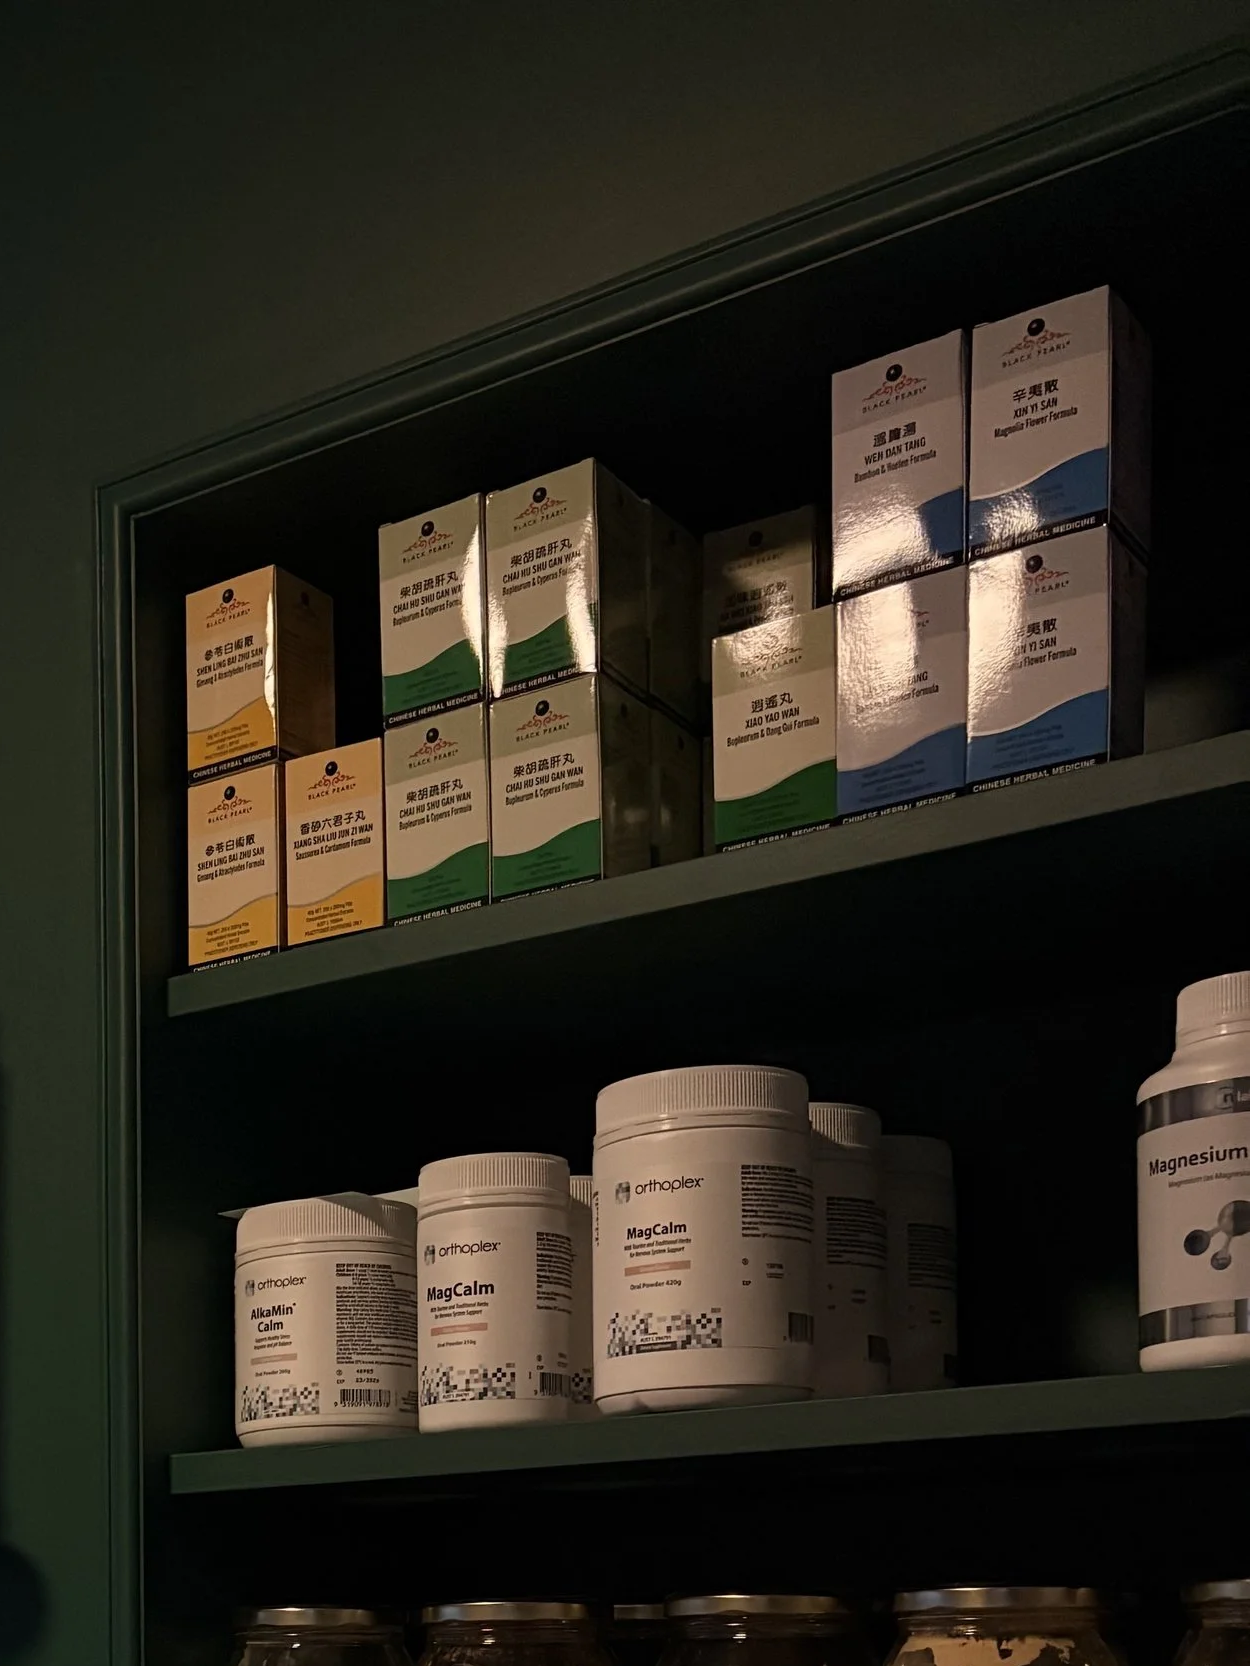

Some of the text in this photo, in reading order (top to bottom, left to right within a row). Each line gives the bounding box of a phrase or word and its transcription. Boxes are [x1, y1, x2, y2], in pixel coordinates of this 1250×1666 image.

[1013, 397, 1058, 418] XIN YI SAN
[994, 405, 1078, 438] Magnolia Flower Formula
[885, 444, 902, 459] DAN
[502, 570, 520, 584] CHAI
[521, 566, 531, 578] HU
[532, 561, 547, 575] SHU
[548, 556, 563, 570] GAN
[206, 609, 249, 629] BLACK PEARL
[1039, 636, 1057, 650] SAN
[196, 647, 263, 677] SHEN LING BAI ZHU SAN
[1024, 646, 1077, 669] Flower Formula
[745, 706, 800, 730] XIAO YAO WAN
[766, 724, 782, 739] Dang
[794, 715, 820, 730] Formula
[516, 723, 567, 742] BLACK PEARL
[193, 750, 271, 779] CHINESE HERBAL MEDICINE
[513, 753, 575, 778] 柴胡疏肝丸
[973, 758, 1096, 793] CHINESE HERBAL MEDICINE
[505, 765, 584, 794] CHAI HU SHU GAN WAN
[399, 791, 472, 819] CHAI HU SHU GAN WAN
[293, 823, 374, 850] XIANG SHA LIU JUN ZI WAN
[197, 846, 265, 871] SHEN LING BAI ZHU SAN
[1149, 1146, 1248, 1176] Magnesium
[635, 1176, 701, 1195] orthoplex
[626, 1222, 687, 1240] MagCalm
[438, 1240, 497, 1257] orthoplex
[257, 1276, 304, 1291] orthoplex
[427, 1280, 495, 1302] MagCalm
[643, 1280, 664, 1289] Powder
[251, 1304, 293, 1321] AlkaMin
[257, 1319, 284, 1333] Calm
